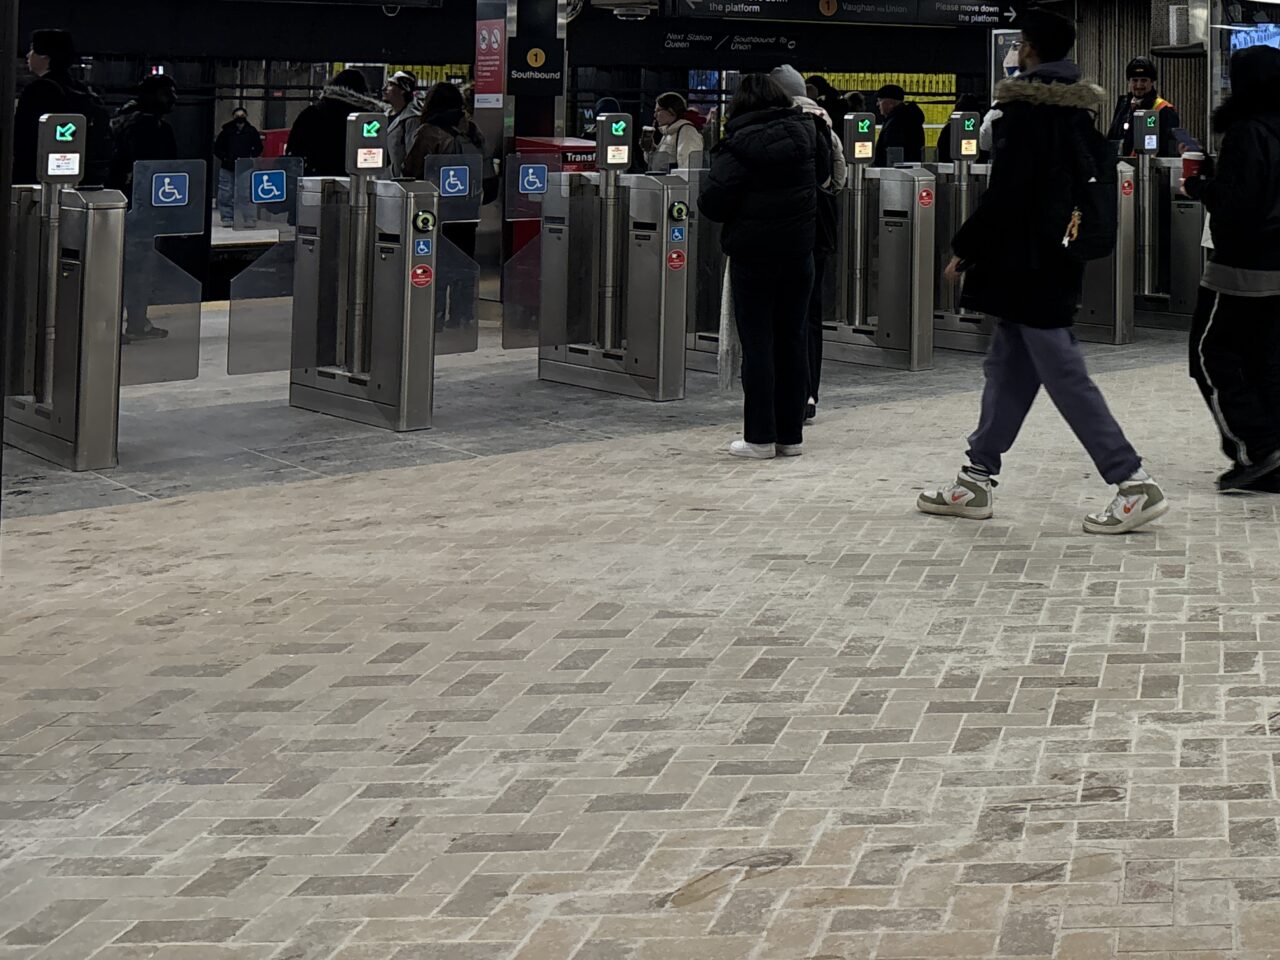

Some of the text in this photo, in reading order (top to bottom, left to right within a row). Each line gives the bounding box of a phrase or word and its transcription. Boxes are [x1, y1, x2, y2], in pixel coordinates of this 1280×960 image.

[709, 2, 761, 14] the platform
[842, 2, 876, 13] Vaughan
[885, 4, 908, 13] Union
[935, 2, 999, 13] Please move down
[958, 14, 999, 24] the platform
[666, 33, 713, 42] Next Station
[664, 40, 690, 49] Queen
[511, 70, 561, 80] Southbound
[566, 152, 596, 162] Transf
